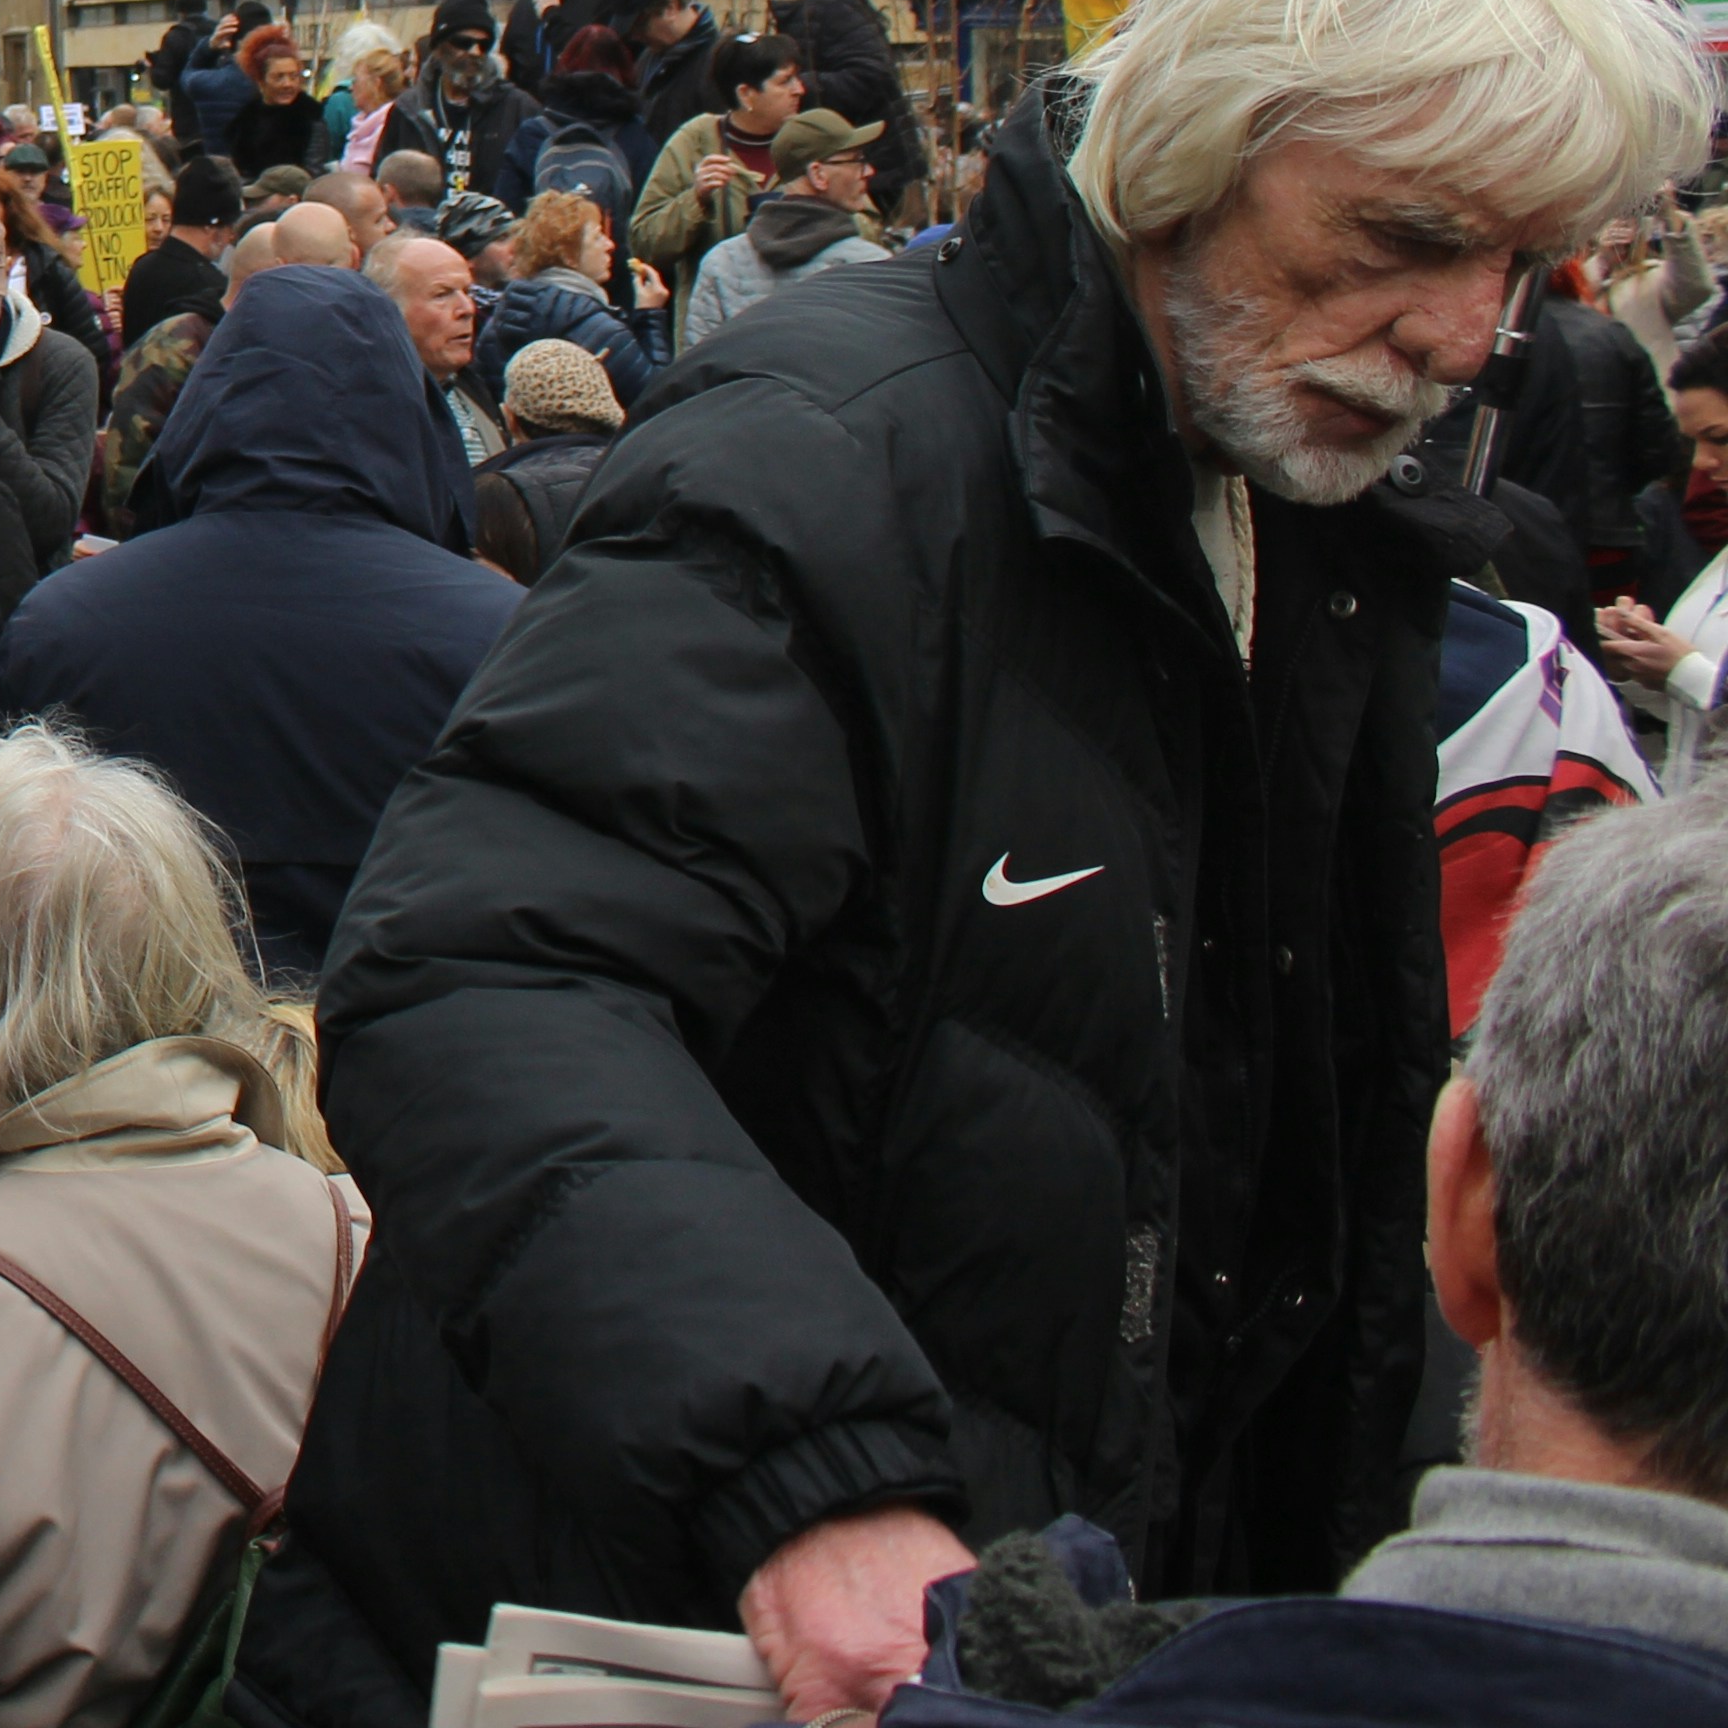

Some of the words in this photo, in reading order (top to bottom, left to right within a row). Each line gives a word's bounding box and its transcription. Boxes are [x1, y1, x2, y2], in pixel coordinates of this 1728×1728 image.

[80, 149, 132, 178] STOP
[78, 176, 138, 203] TRAFFIC
[98, 233, 122, 255] NO
